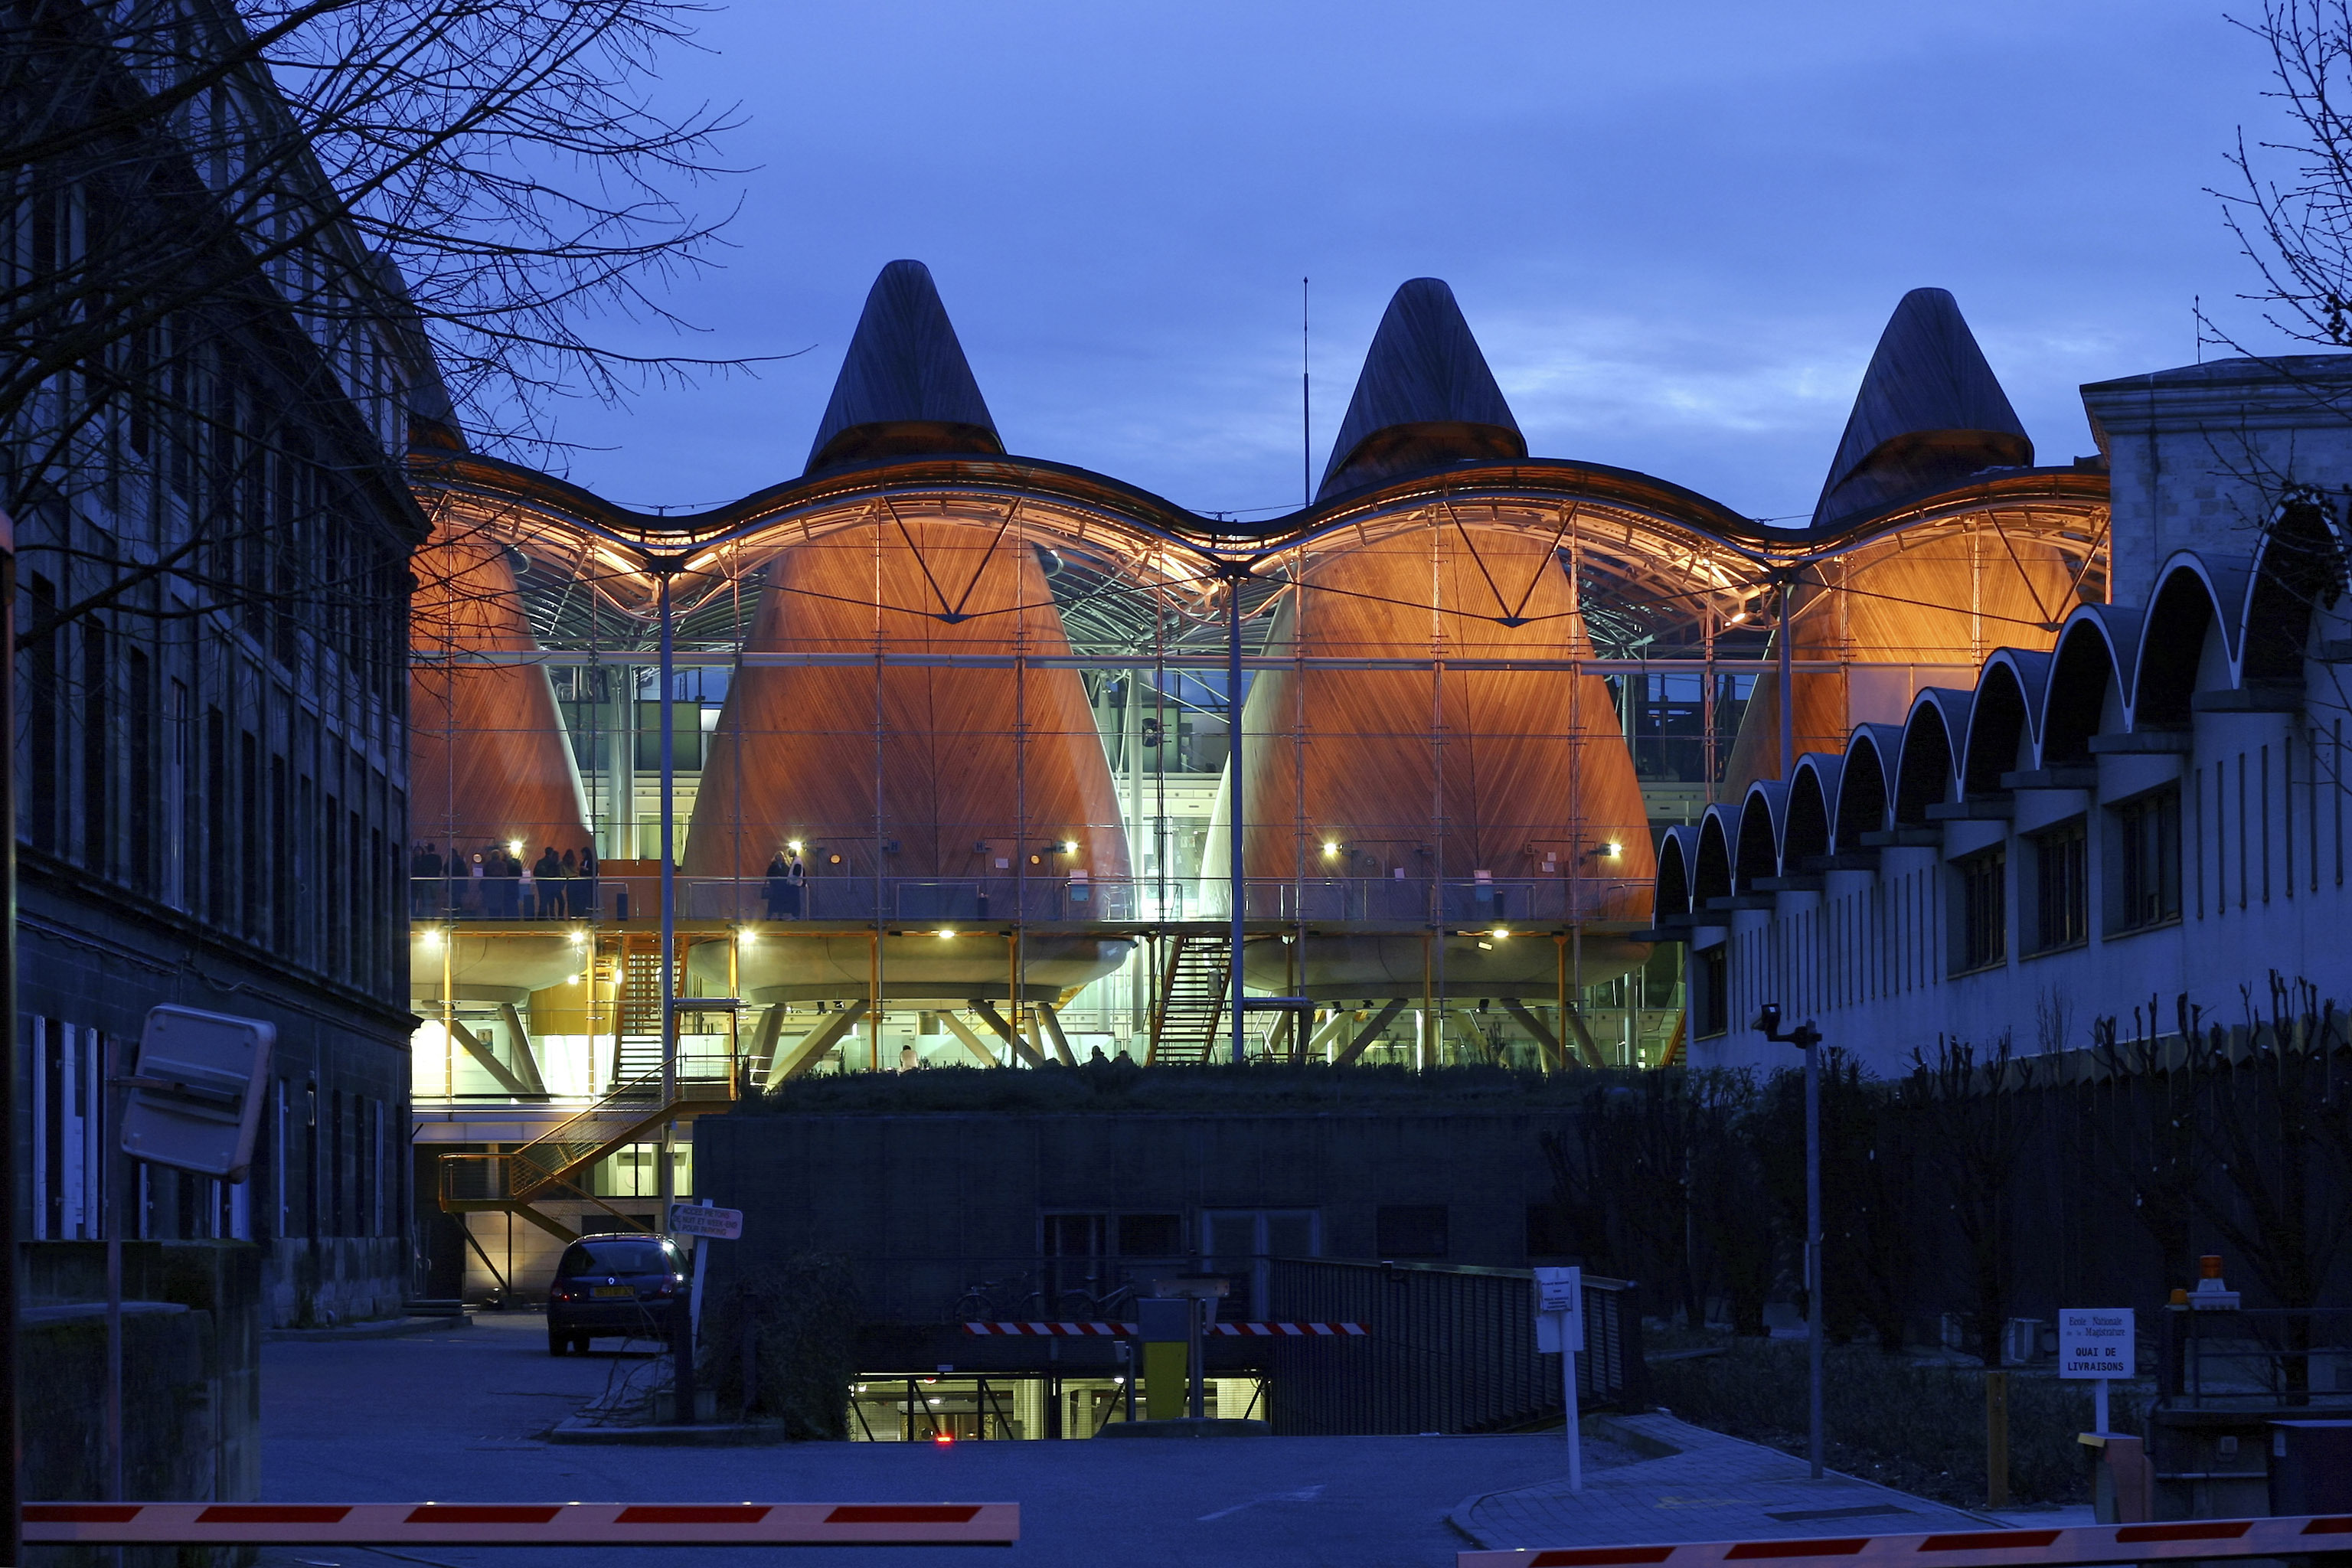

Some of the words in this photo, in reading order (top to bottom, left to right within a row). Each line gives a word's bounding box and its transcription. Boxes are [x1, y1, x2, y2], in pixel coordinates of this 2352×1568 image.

[891, 842, 898, 851] H
[976, 842, 983, 851] H
[704, 1209, 730, 1219] PIETONS
[707, 1219, 738, 1229] WEEK-END
[682, 1223, 699, 1232] POUR
[701, 1226, 727, 1236] PARKING
[2092, 1317, 2122, 1325] Nationale
[2086, 1328, 2125, 1338] Magistrature
[2076, 1348, 2098, 1357] QUAI
[2105, 1348, 2116, 1357] DE
[2068, 1362, 2124, 1371] LIVRAISONS
